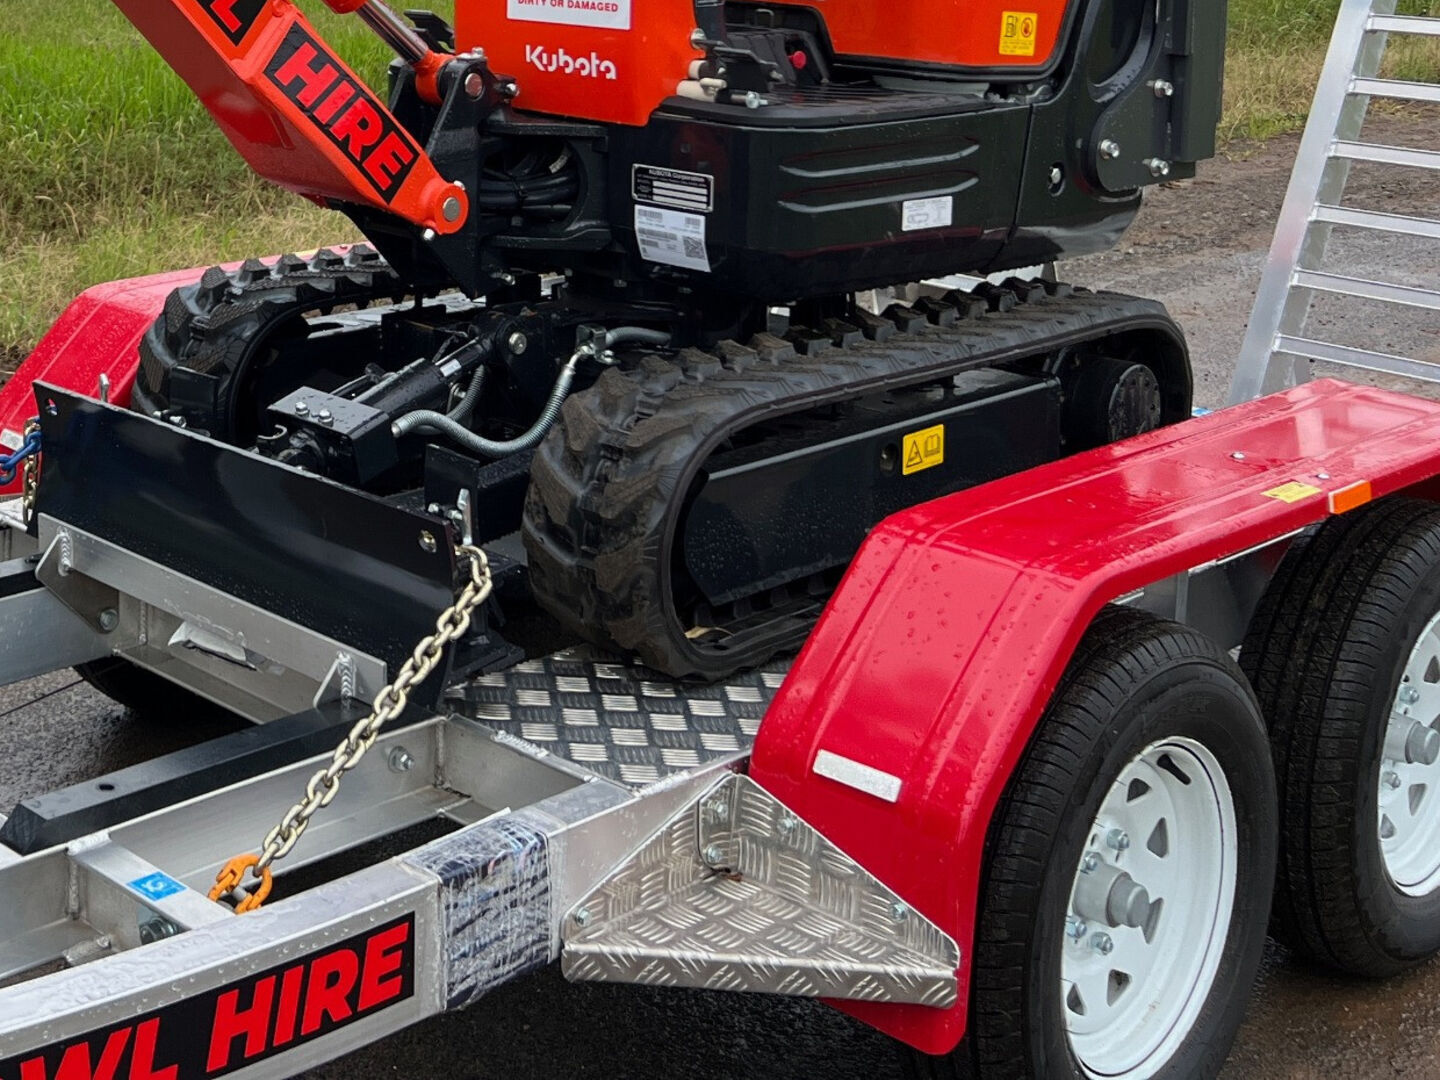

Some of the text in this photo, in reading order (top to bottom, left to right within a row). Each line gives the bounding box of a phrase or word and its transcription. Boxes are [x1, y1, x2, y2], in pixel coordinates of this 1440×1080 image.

[567, 0, 618, 12] DAMAGED
[525, 44, 616, 80] Kubota
[274, 41, 413, 191] HIRE
[206, 921, 410, 1073] HIRE
